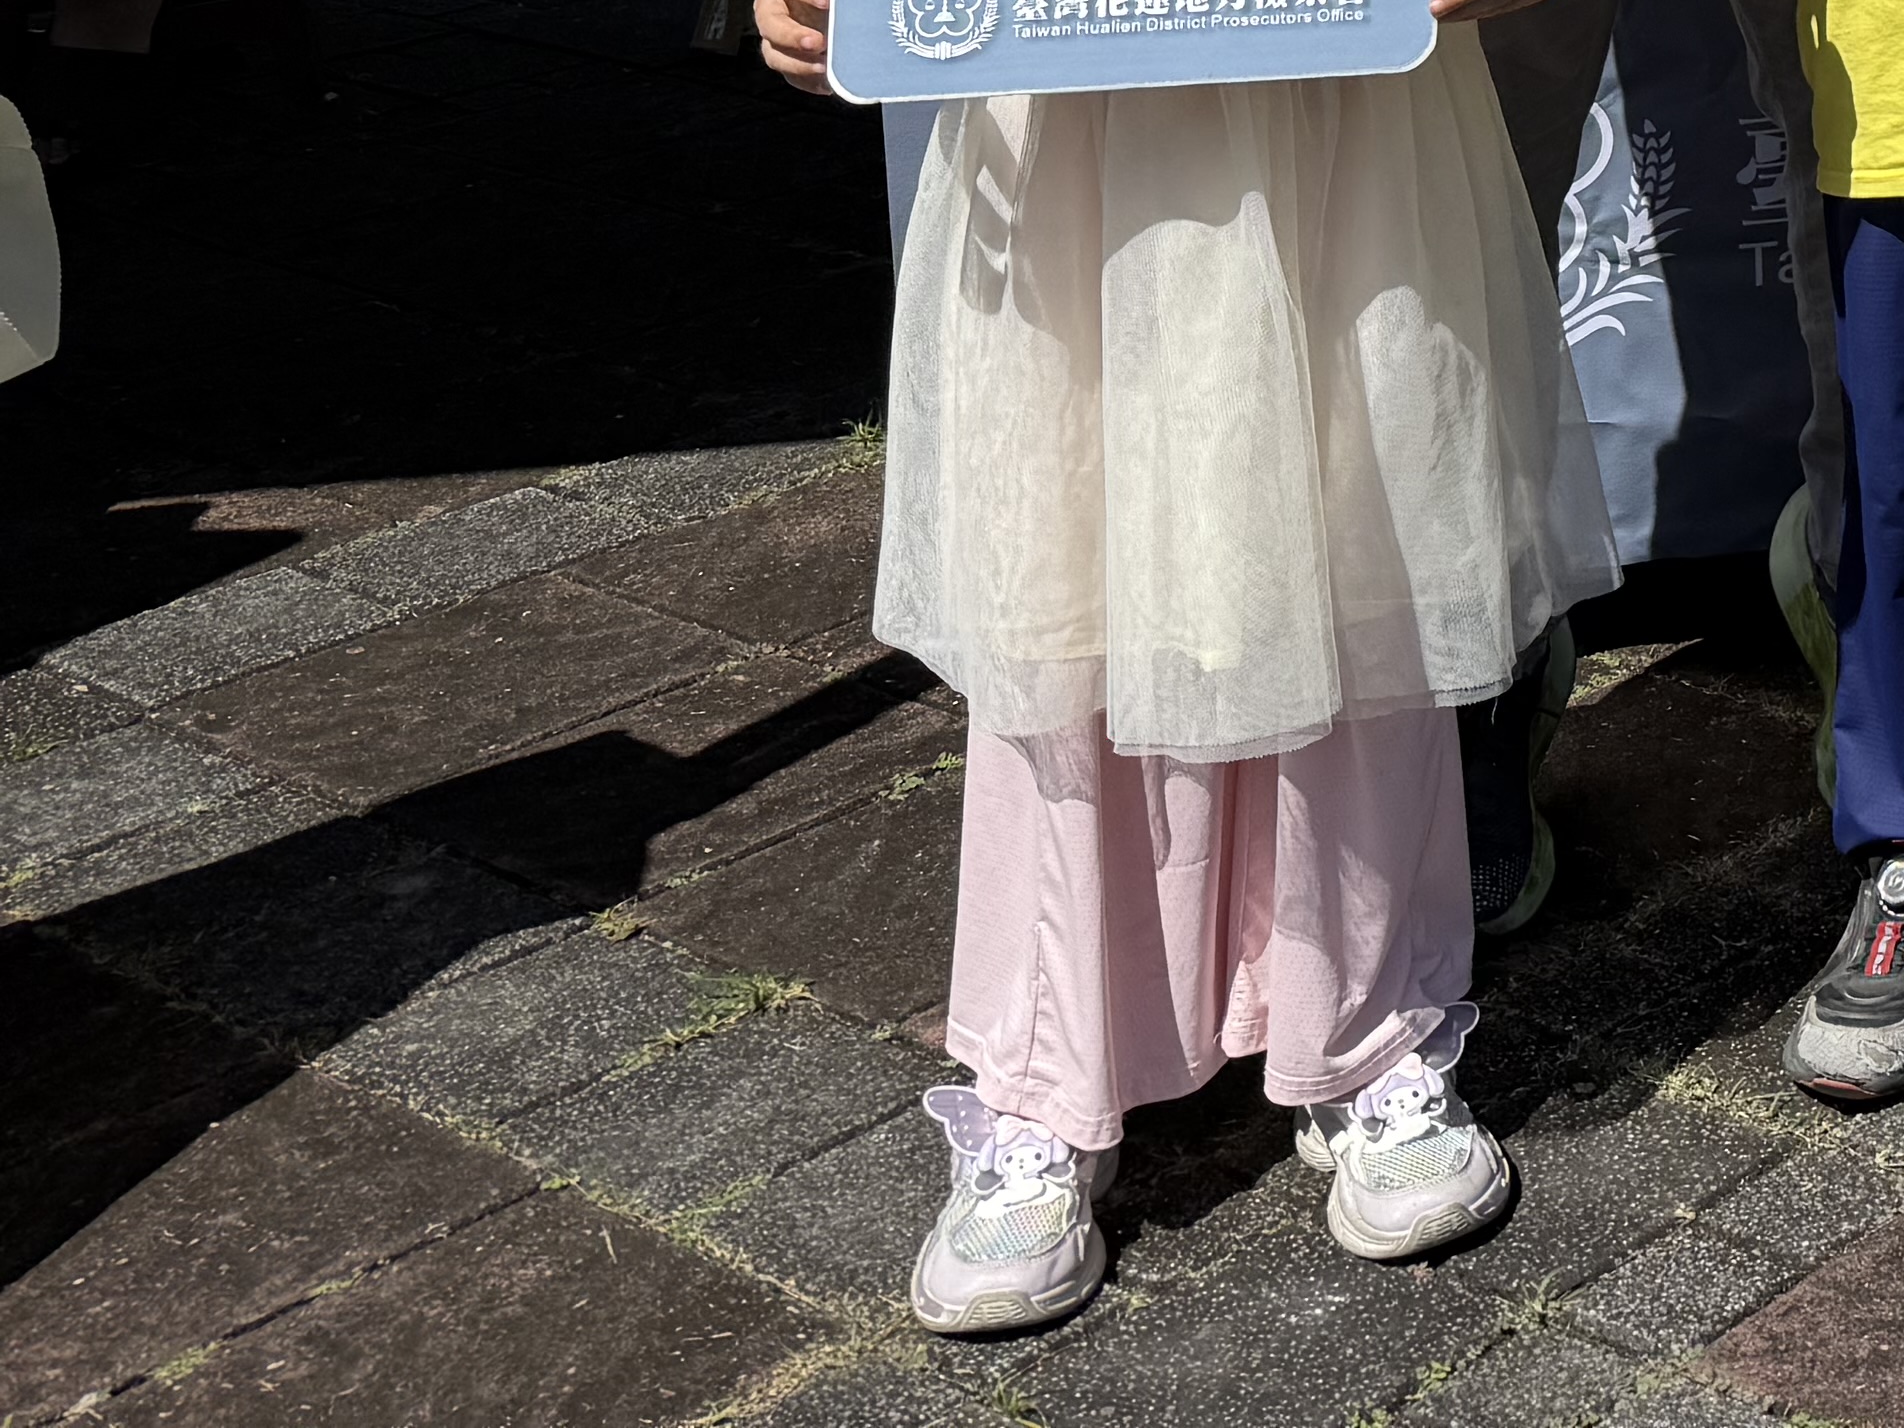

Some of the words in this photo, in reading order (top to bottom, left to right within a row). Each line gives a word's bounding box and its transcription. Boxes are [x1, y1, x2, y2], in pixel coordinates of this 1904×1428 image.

[1012, 23, 1072, 39] Taiwan
[1076, 20, 1142, 36] Hualien
[1146, 16, 1207, 32] District
[1211, 11, 1313, 29] Prosecutors
[1317, 7, 1365, 23] Office
